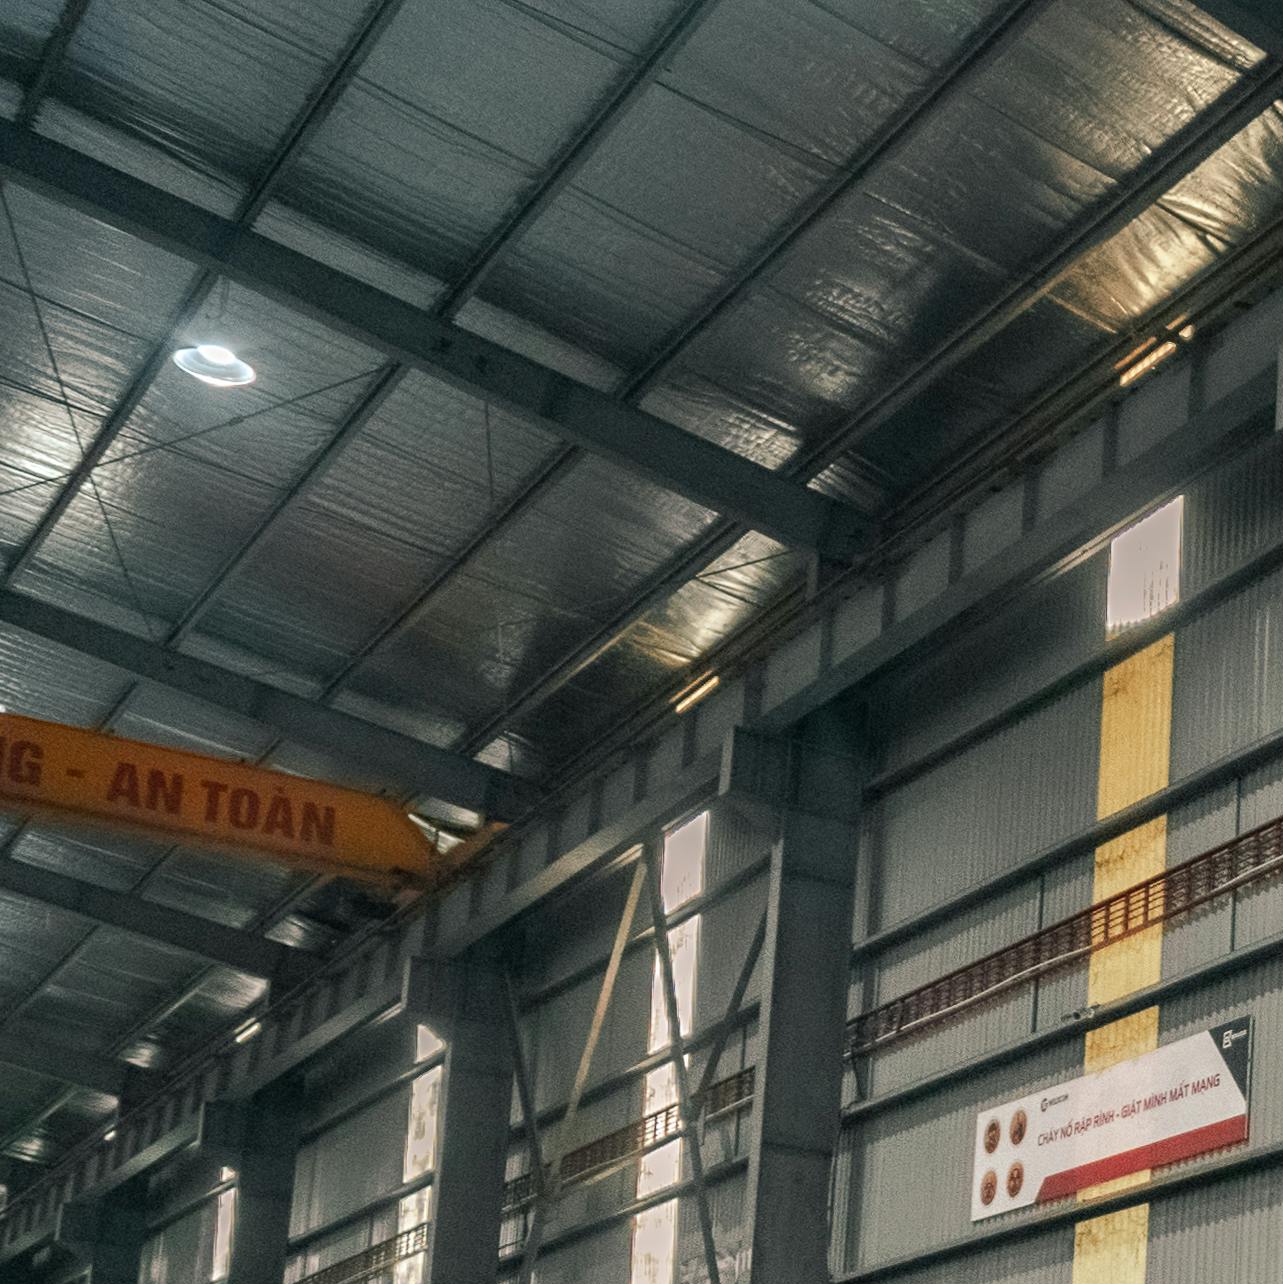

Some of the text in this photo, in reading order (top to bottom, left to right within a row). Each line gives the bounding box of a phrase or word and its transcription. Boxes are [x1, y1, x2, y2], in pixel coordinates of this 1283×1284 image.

[0, 736, 44, 787] G
[107, 761, 184, 815] AN
[201, 778, 336, 845] TOÀN
